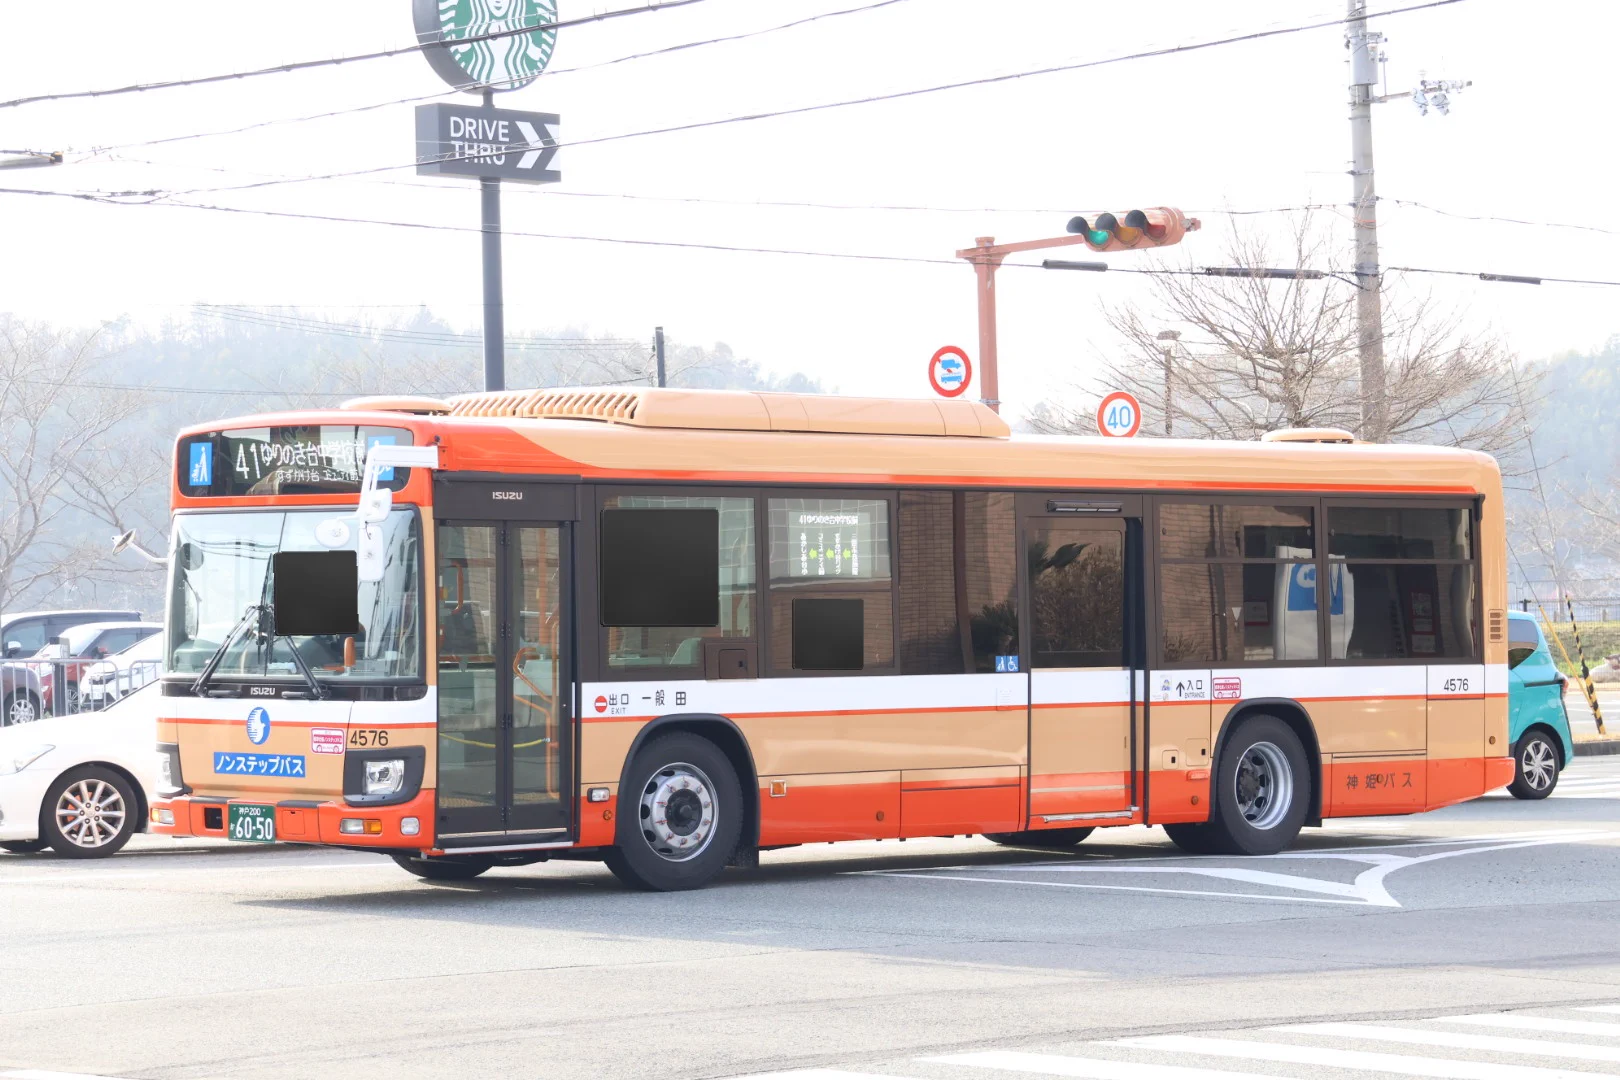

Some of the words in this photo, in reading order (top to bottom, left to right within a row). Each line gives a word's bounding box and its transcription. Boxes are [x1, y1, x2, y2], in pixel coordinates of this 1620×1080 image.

[450, 116, 510, 142] DRIVE
[451, 140, 506, 166] THRU
[1107, 406, 1131, 429] 40
[236, 443, 261, 480] 41
[492, 491, 523, 500] ISUZU
[250, 687, 276, 696] ISUZU
[1187, 680, 1203, 690] 入口
[1443, 678, 1469, 692] 4576
[609, 693, 629, 706] 出口
[641, 689, 666, 706] 一般
[675, 691, 687, 706] 田
[611, 707, 626, 715] EXIT
[350, 730, 389, 747] 4576
[215, 754, 305, 776] ノンステップバス
[1346, 772, 1413, 790] 神姫バス
[235, 816, 273, 840] 60-50
